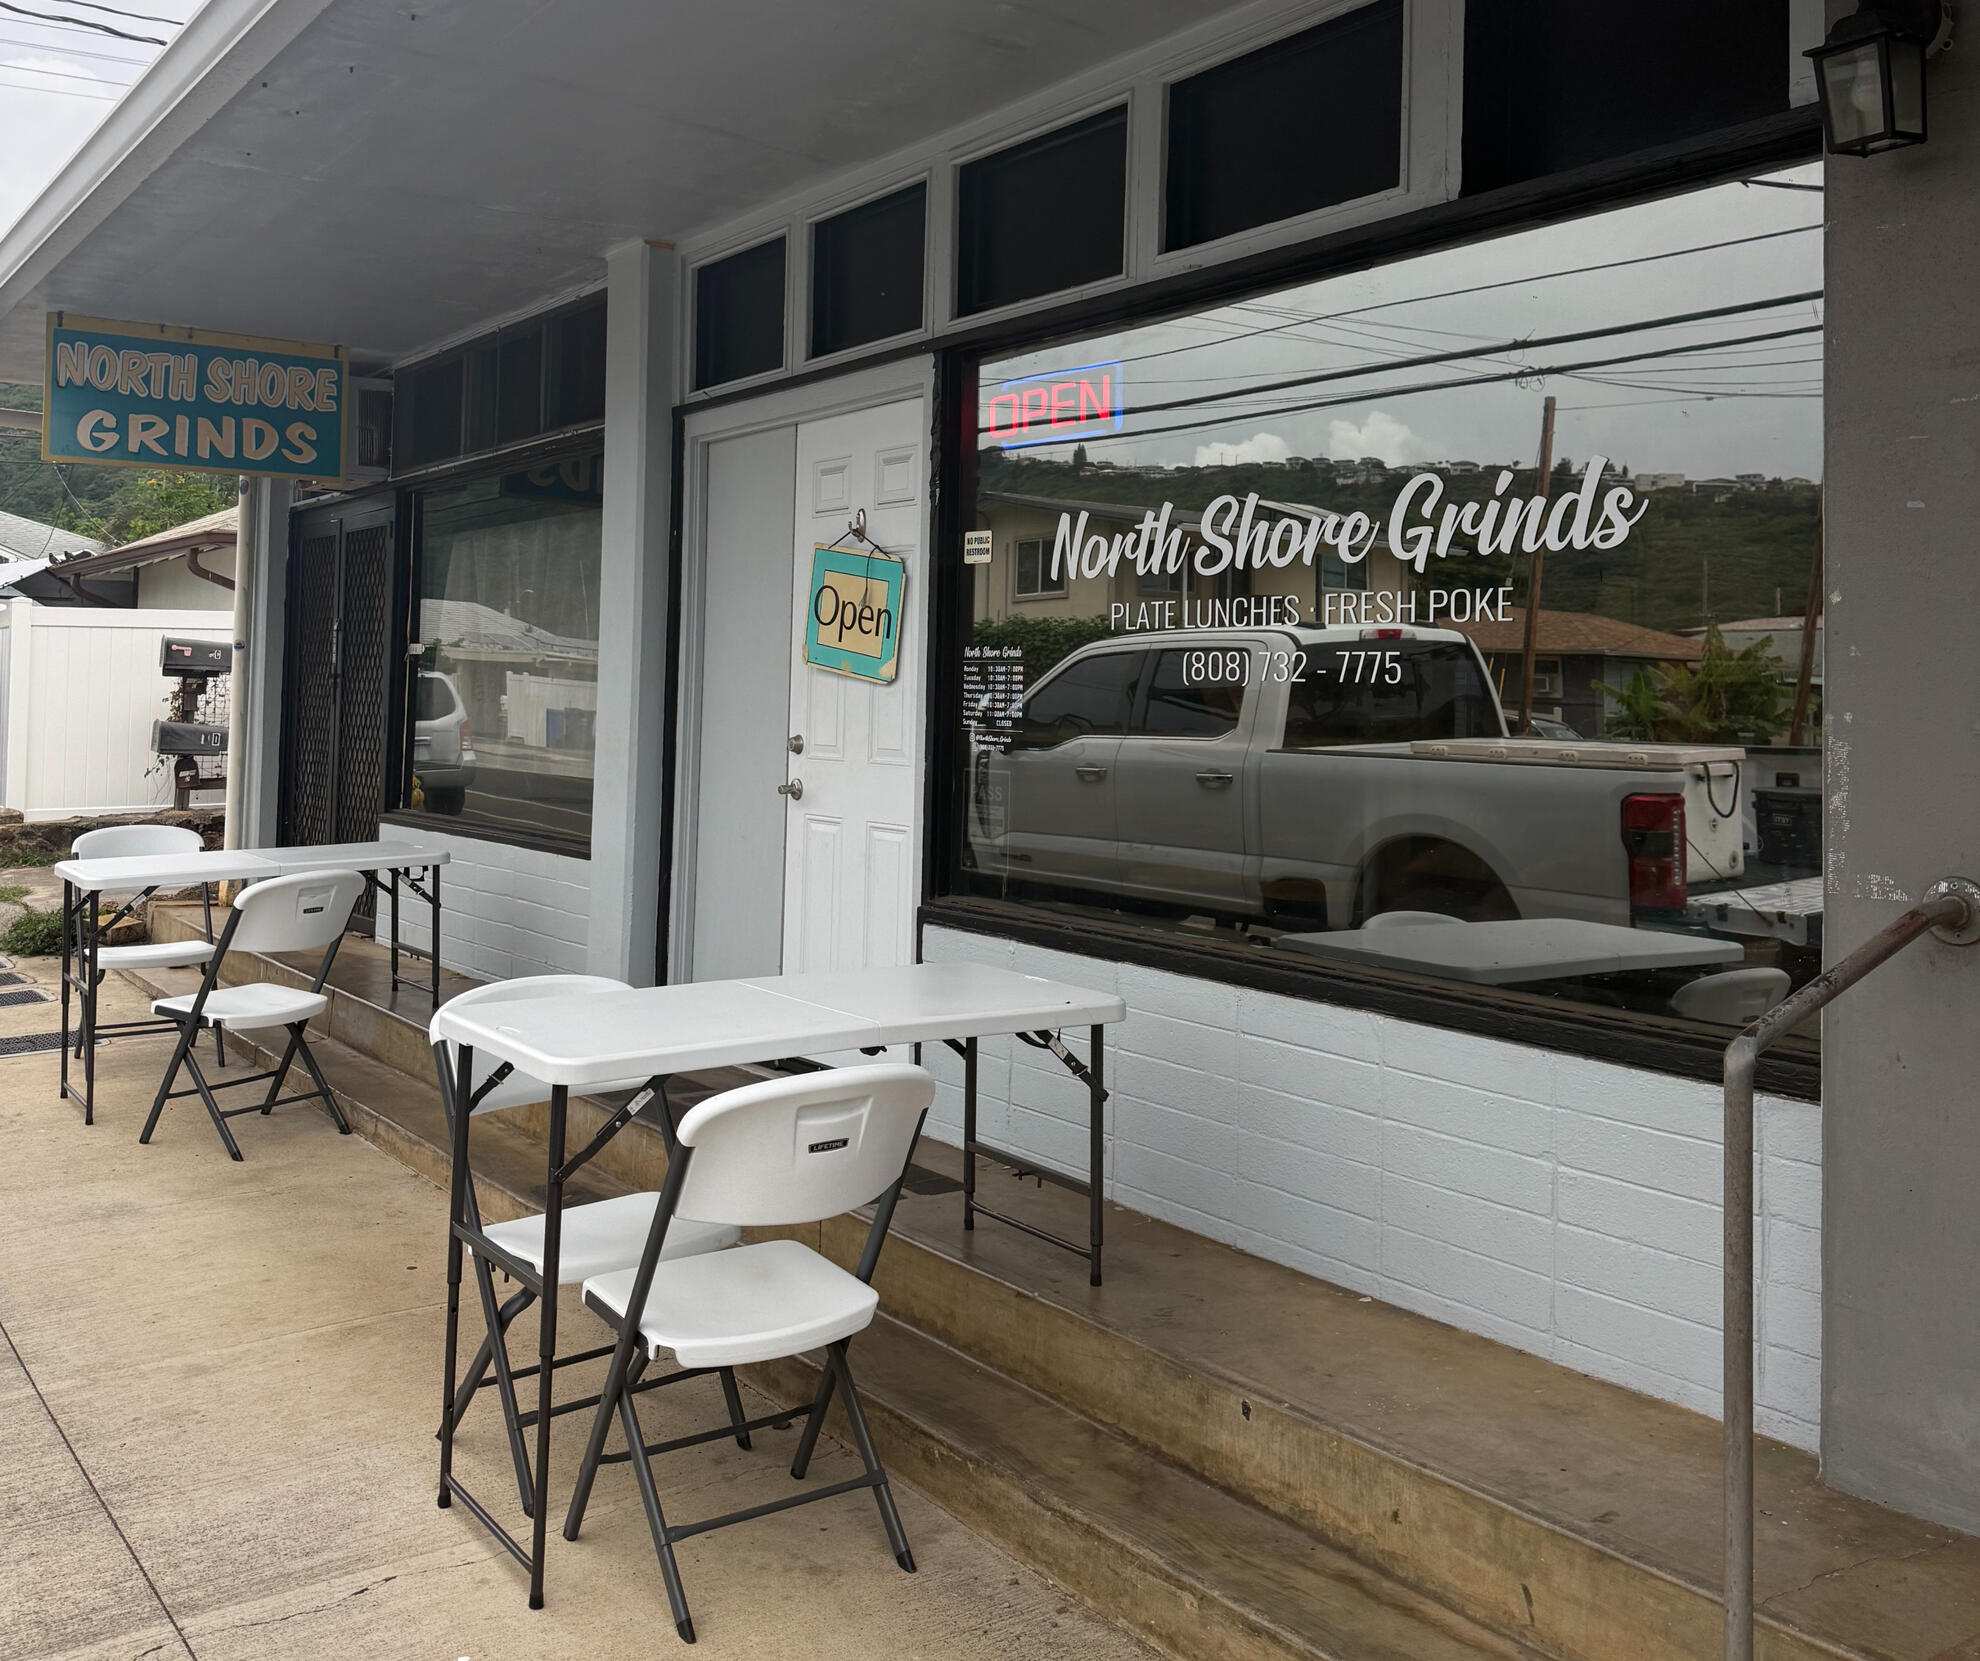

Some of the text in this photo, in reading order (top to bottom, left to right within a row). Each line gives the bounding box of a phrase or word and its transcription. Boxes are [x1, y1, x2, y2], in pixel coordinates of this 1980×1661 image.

[56, 341, 338, 412] NORTH SHORE
[989, 375, 1110, 438] OPEN
[76, 409, 319, 464] GRINDS
[1050, 455, 1650, 582] North Shore Grinds
[966, 547, 990, 556] RESTROOM
[967, 536, 990, 545] NO PUBLIC
[814, 585, 892, 643] Open
[1110, 600, 1177, 631] PLATE
[1183, 595, 1300, 629] LUNCHES
[1322, 590, 1417, 625] FRESH
[1428, 587, 1515, 623] POKE
[964, 646, 1022, 659] North Shore Grinds
[1182, 651, 1250, 687] (808)
[1258, 651, 1307, 683] 732
[1335, 650, 1402, 684] 7775
[963, 692, 983, 700] Thursday
[963, 701, 978, 709] Friday
[963, 710, 983, 718] Saturday
[963, 718, 978, 726] Sunday
